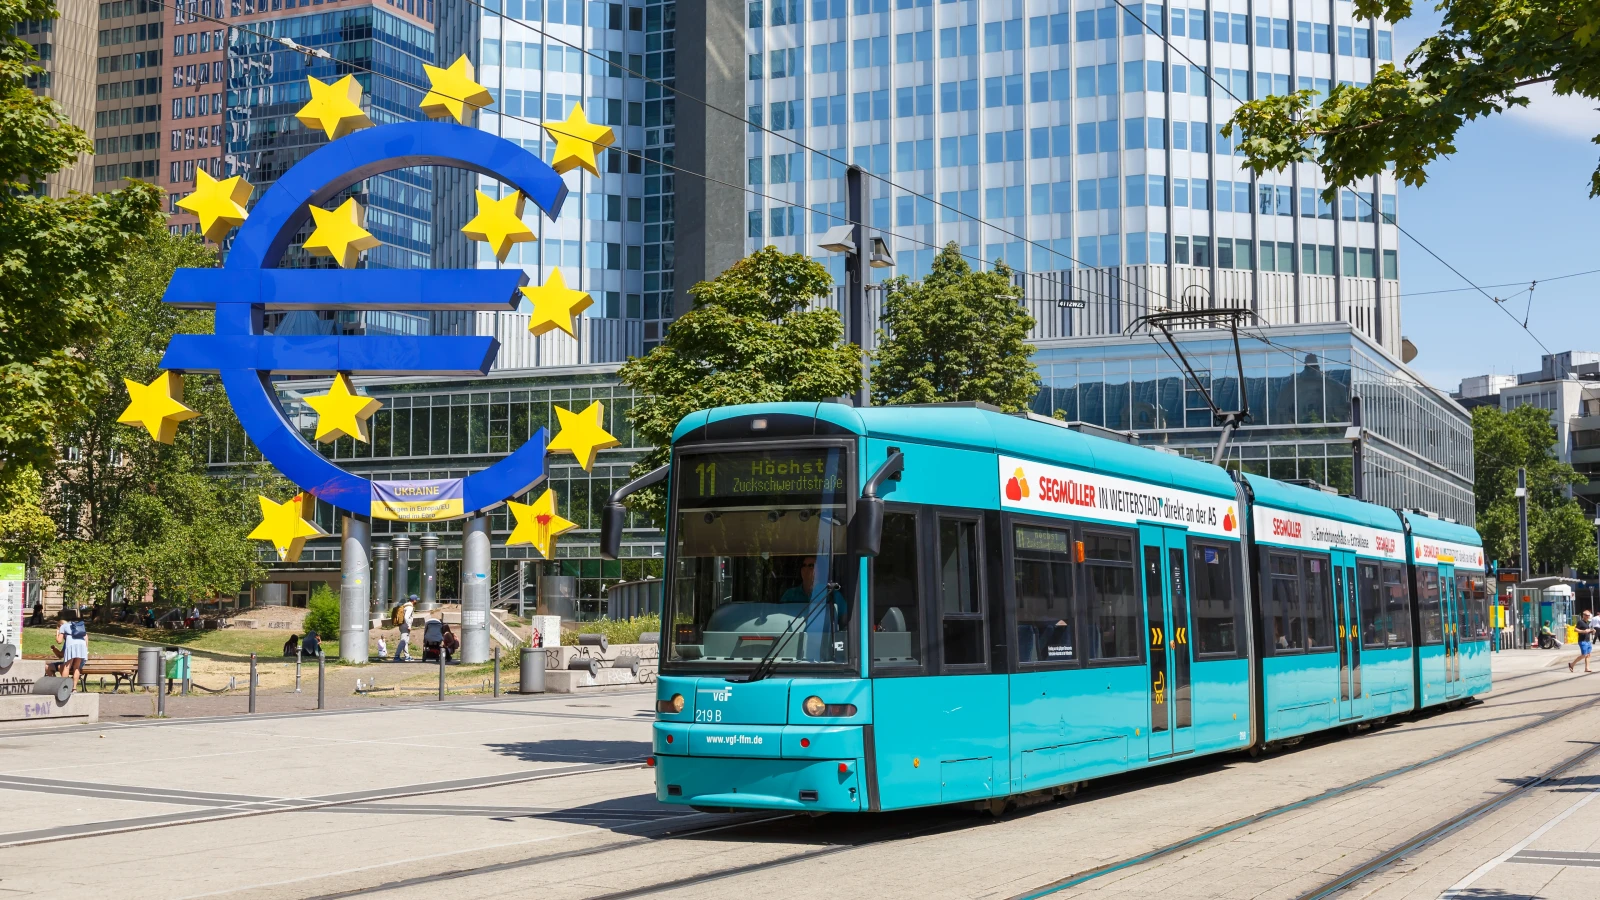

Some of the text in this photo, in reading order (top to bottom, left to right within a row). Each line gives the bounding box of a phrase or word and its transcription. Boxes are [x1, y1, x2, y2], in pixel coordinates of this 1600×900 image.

[751, 458, 825, 476] Höchst
[695, 462, 716, 496] 11
[733, 475, 843, 493] Zuckschwerdtstraße
[393, 486, 440, 496] UKRAINE
[1039, 475, 1217, 526] SEGMÜLLER IN WEITERSTADT direkt an der A5
[1273, 517, 1302, 538] SEGMÜLLER
[713, 686, 733, 702] VGF
[696, 709, 722, 722] 219 B
[706, 734, 763, 745] www.vgf-ffm.de
